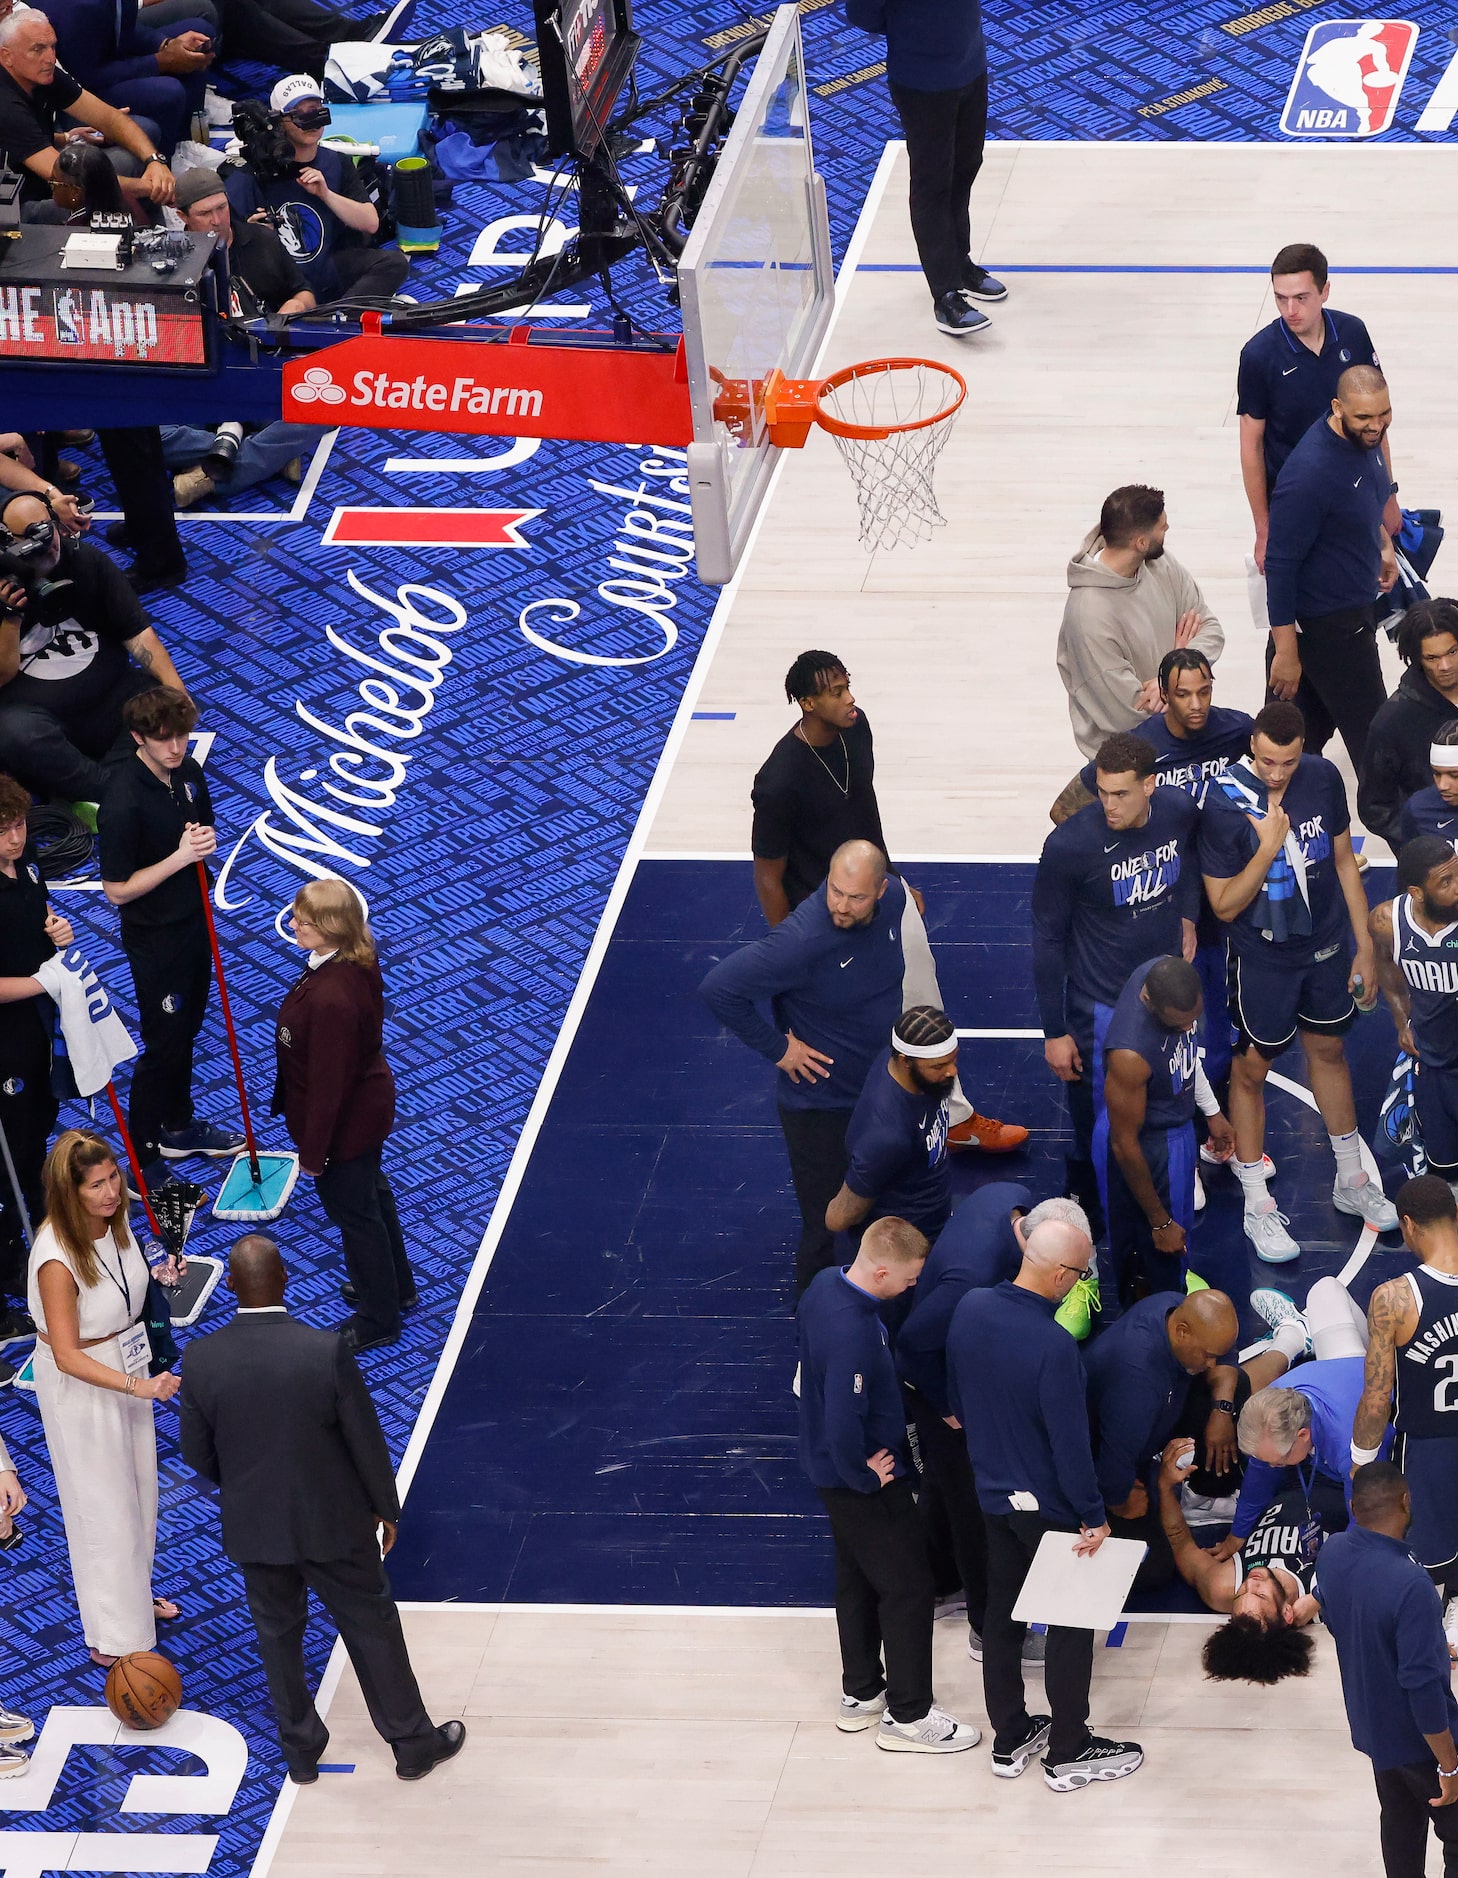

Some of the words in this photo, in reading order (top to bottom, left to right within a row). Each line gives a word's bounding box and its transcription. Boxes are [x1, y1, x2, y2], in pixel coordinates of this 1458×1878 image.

[1007, 49, 1100, 90] BUCKNER
[1008, 33, 1065, 62] KURT
[813, 78, 849, 97] BRIAN
[1137, 103, 1166, 118] PEJA
[1296, 109, 1347, 129] NBA
[89, 289, 158, 359] App
[516, 474, 594, 509] JASON
[582, 451, 643, 484] KIDD
[555, 548, 593, 571] BRIAN
[487, 660, 569, 697] TYSON
[442, 704, 528, 748] WESLEY
[518, 665, 635, 716] MATTHEWS
[560, 703, 620, 736] DALE
[606, 684, 671, 716] ELLIS
[374, 833, 463, 875] DWIGHT
[451, 804, 541, 845] POWELL
[389, 801, 468, 849] TARPLEY
[469, 831, 540, 867] TERRY
[530, 808, 600, 843] DAVIS
[521, 840, 577, 870] RODNEY
[570, 819, 628, 849] MCCRAY
[1299, 814, 1325, 841] FOR
[1110, 859, 1143, 881] ONE
[1155, 839, 1178, 867] FOR
[425, 880, 487, 916] KIDD
[432, 902, 504, 938] JAMAL
[494, 857, 609, 913] MASHBURN
[501, 906, 547, 930] CEDRIC
[540, 884, 601, 914] CEBALLOS
[1126, 867, 1168, 906] ALL
[390, 987, 427, 1009] BRIAN
[424, 966, 488, 995] CARDINAL
[394, 986, 479, 1031] TERRY
[456, 1021, 498, 1045] A.C.
[486, 998, 550, 1030] GREEN
[394, 1060, 509, 1119] CHANDLER
[481, 1072, 537, 1101] MAYO
[393, 1156, 456, 1189] DALE
[440, 1133, 506, 1169] ELLIS
